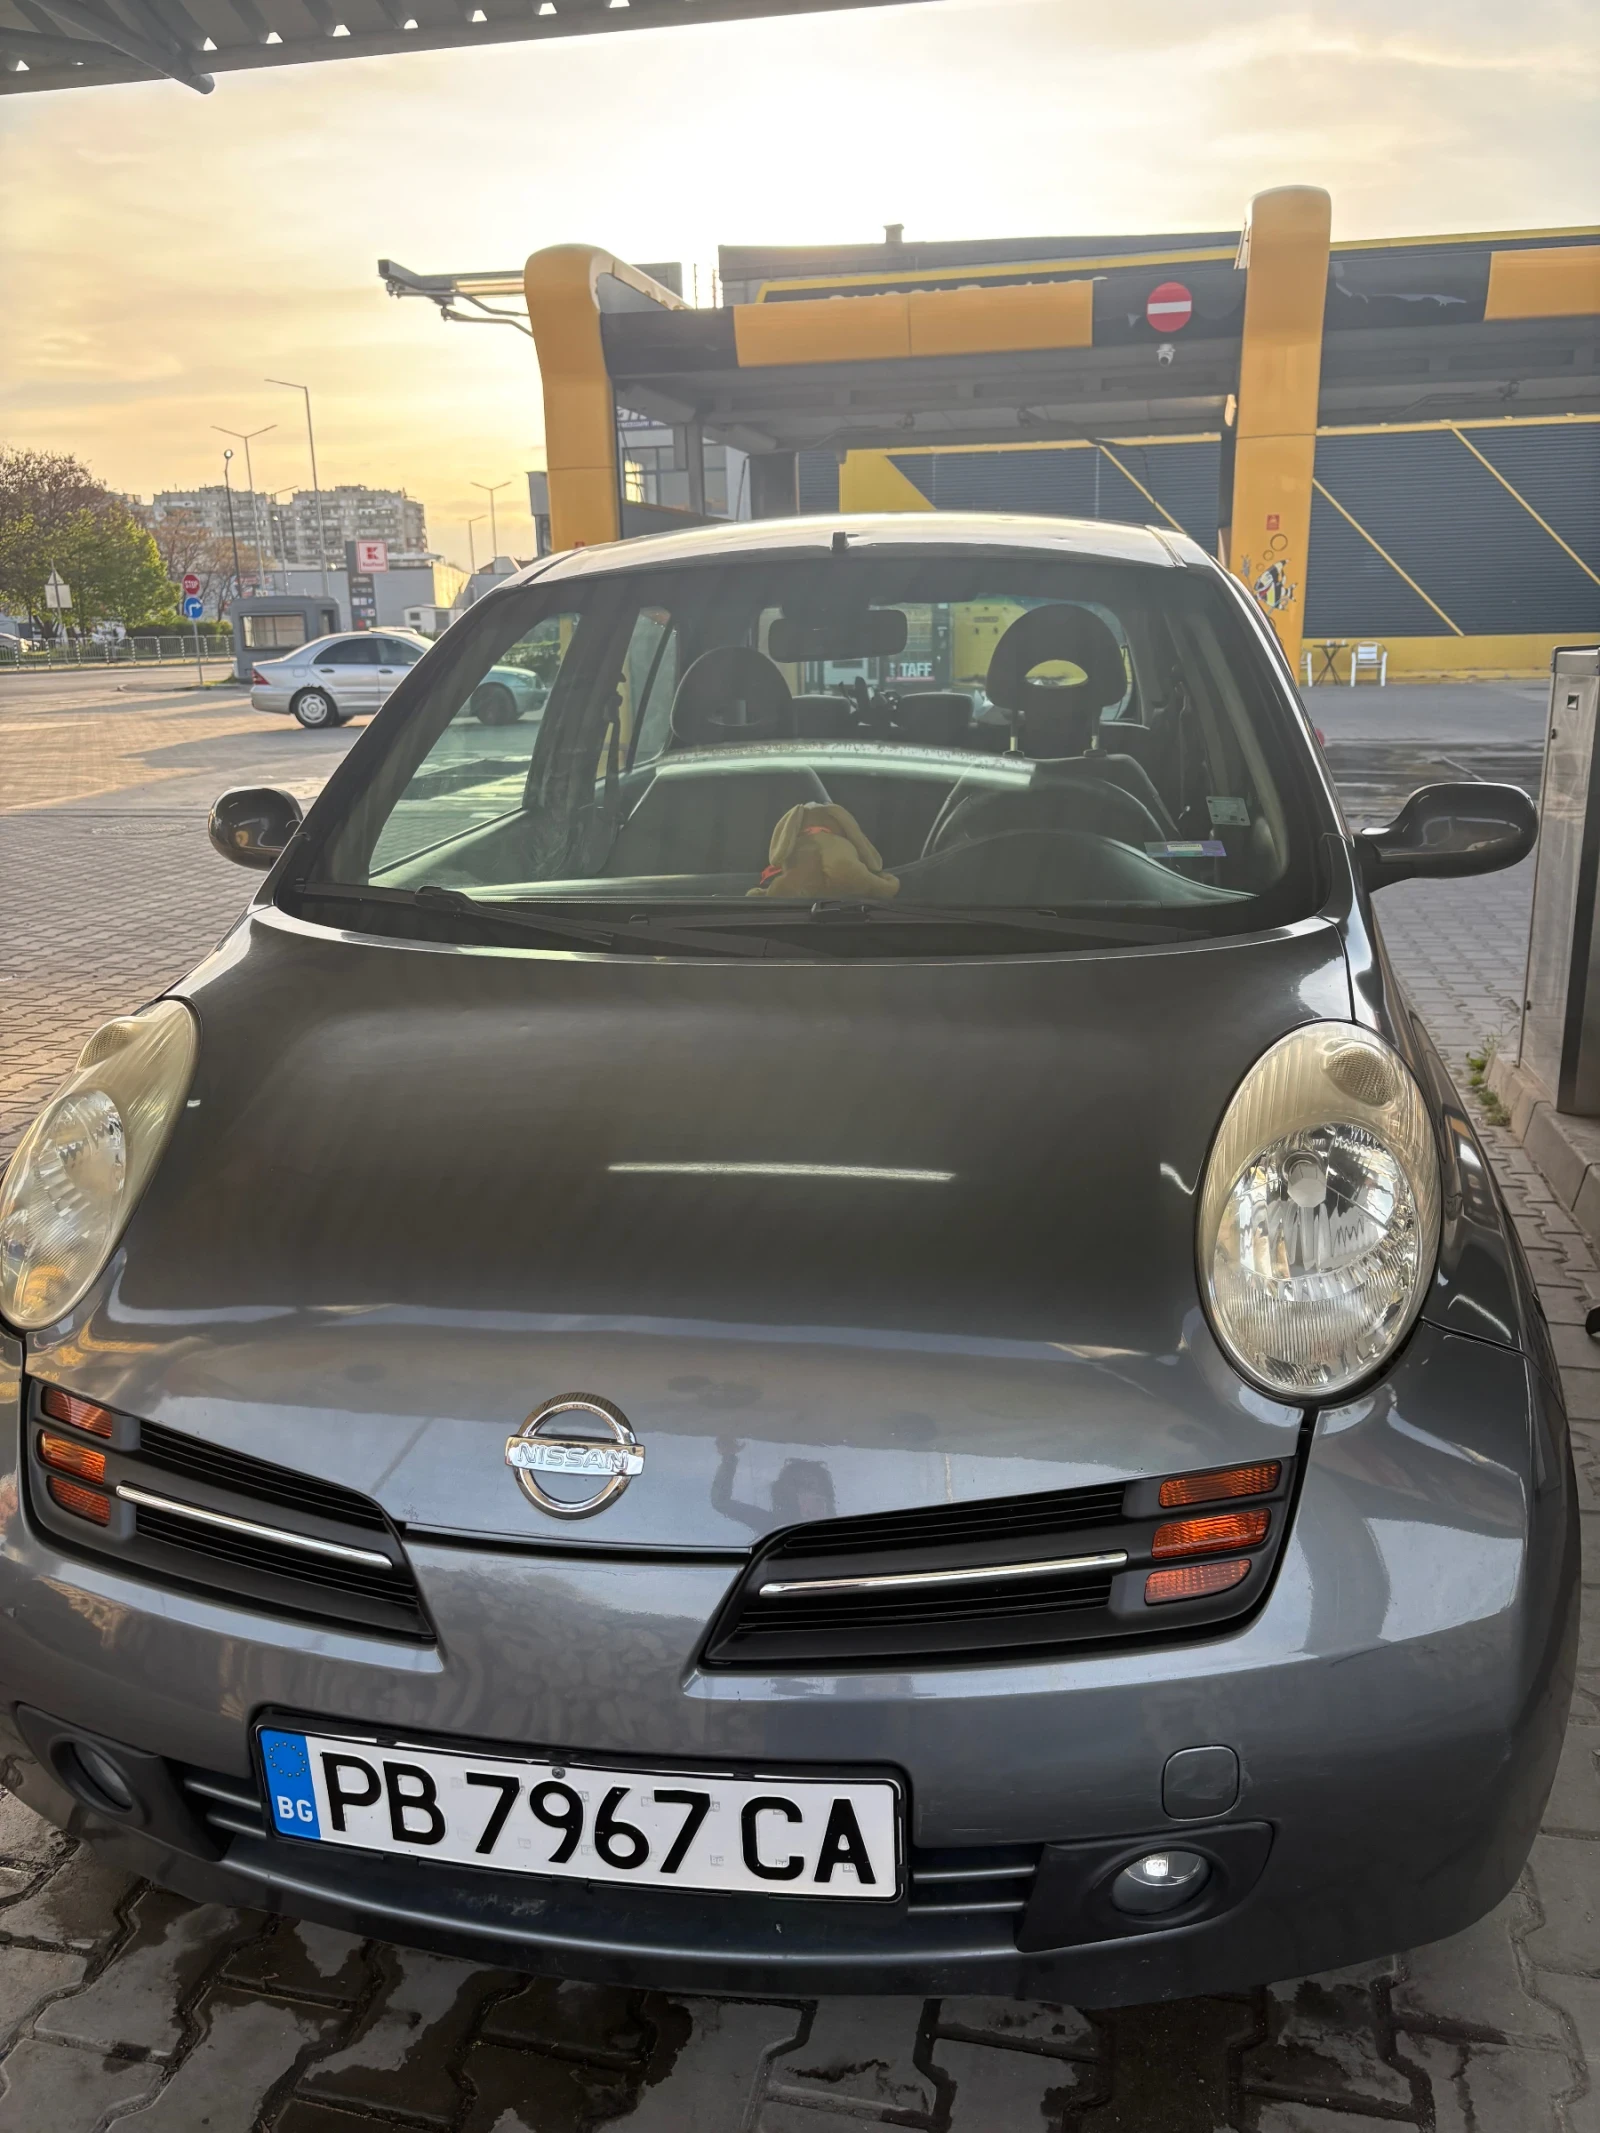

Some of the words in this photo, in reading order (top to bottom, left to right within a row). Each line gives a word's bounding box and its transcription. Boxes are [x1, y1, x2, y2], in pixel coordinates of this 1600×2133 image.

[184, 580, 199, 589] STOP
[517, 1442, 629, 1470] NISSAN
[276, 1795, 314, 1823] BG
[319, 1751, 446, 1845] PB
[465, 1771, 711, 1874] 7967
[741, 1796, 876, 1884] CA
